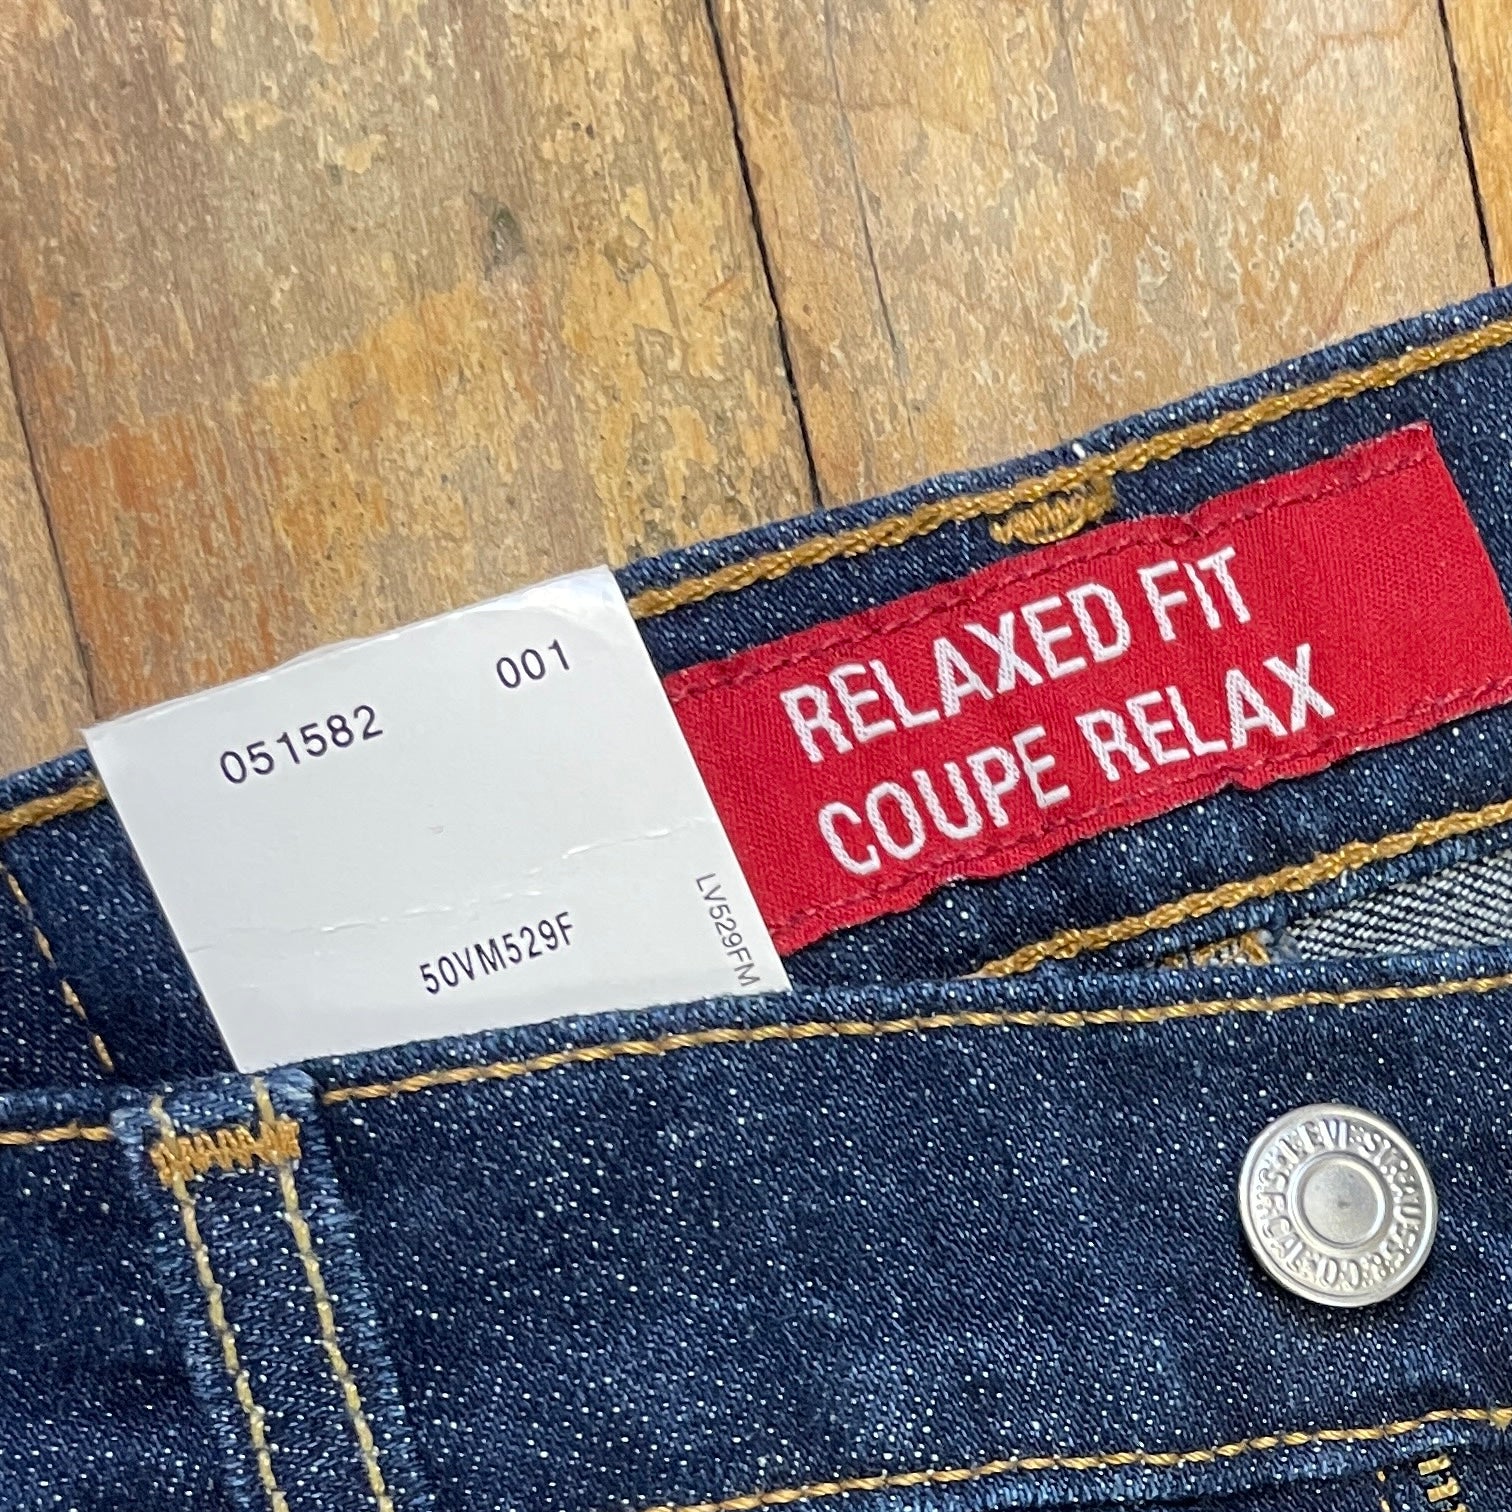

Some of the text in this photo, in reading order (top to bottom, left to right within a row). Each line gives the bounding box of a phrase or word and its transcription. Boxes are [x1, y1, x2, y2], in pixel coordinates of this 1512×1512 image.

[496, 640, 571, 689] 001
[781, 546, 1255, 763] RELAXED FIT
[219, 704, 383, 784] 051582
[817, 643, 1336, 875] COUPE RELAX
[419, 910, 577, 995] 50VM529F
[695, 872, 761, 987] LV529FM
